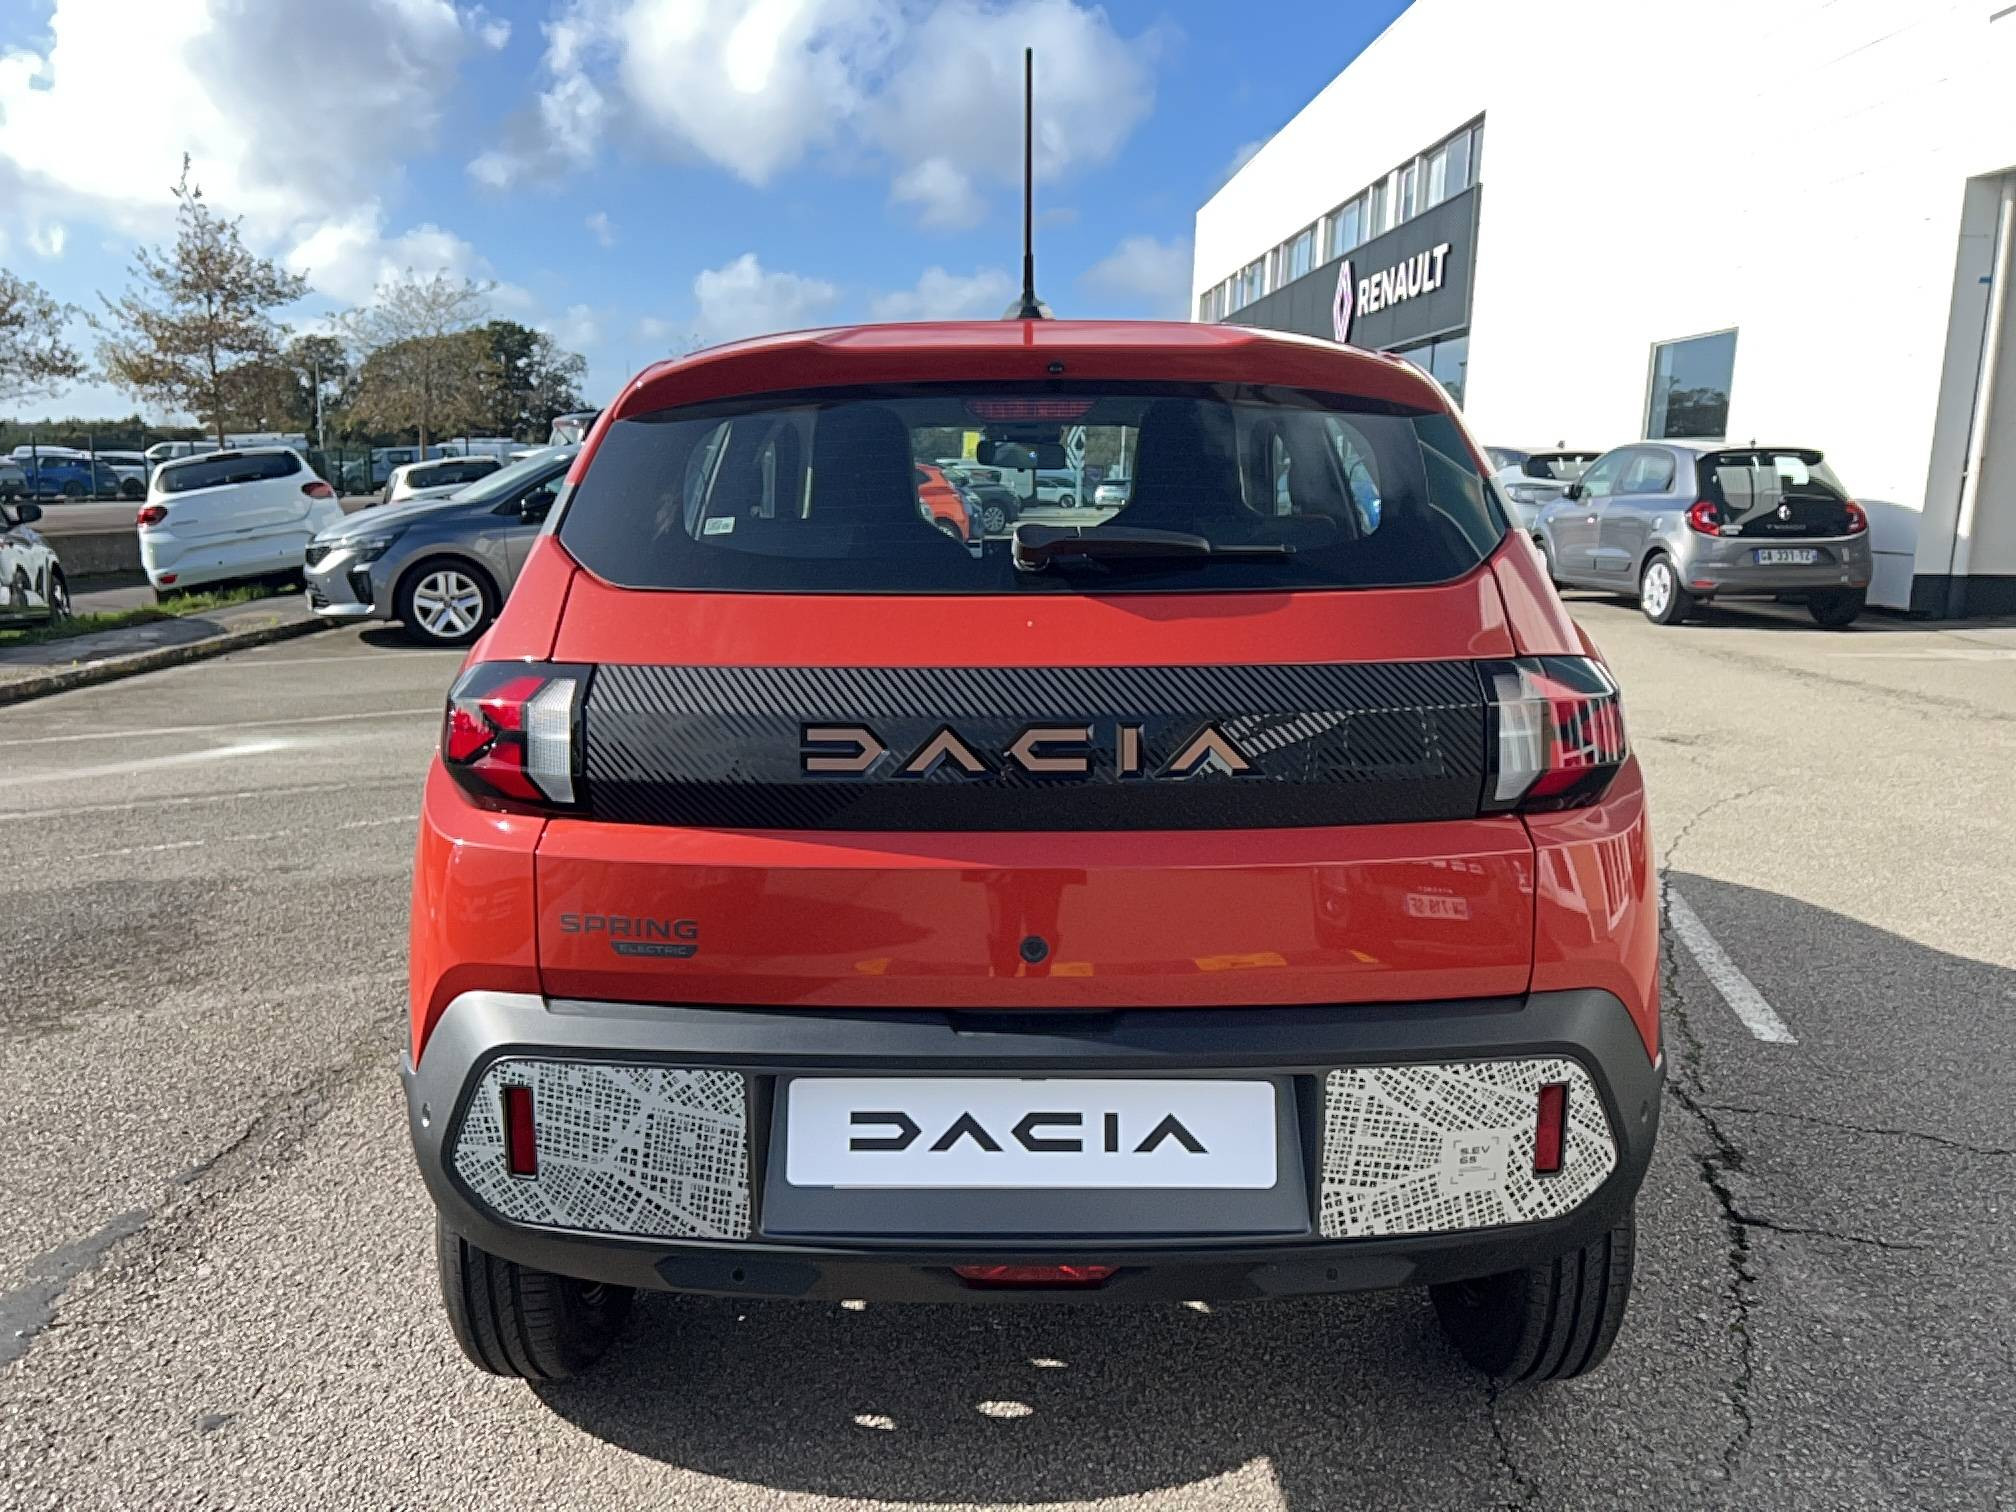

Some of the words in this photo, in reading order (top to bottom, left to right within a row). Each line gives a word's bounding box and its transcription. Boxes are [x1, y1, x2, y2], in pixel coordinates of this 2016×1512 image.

[1357, 243, 1450, 317] RENAULT
[801, 722, 1262, 778] DACIA
[560, 913, 698, 939] SPRING
[618, 943, 688, 955] ELECTRIC
[850, 1110, 1210, 1153] DACIA
